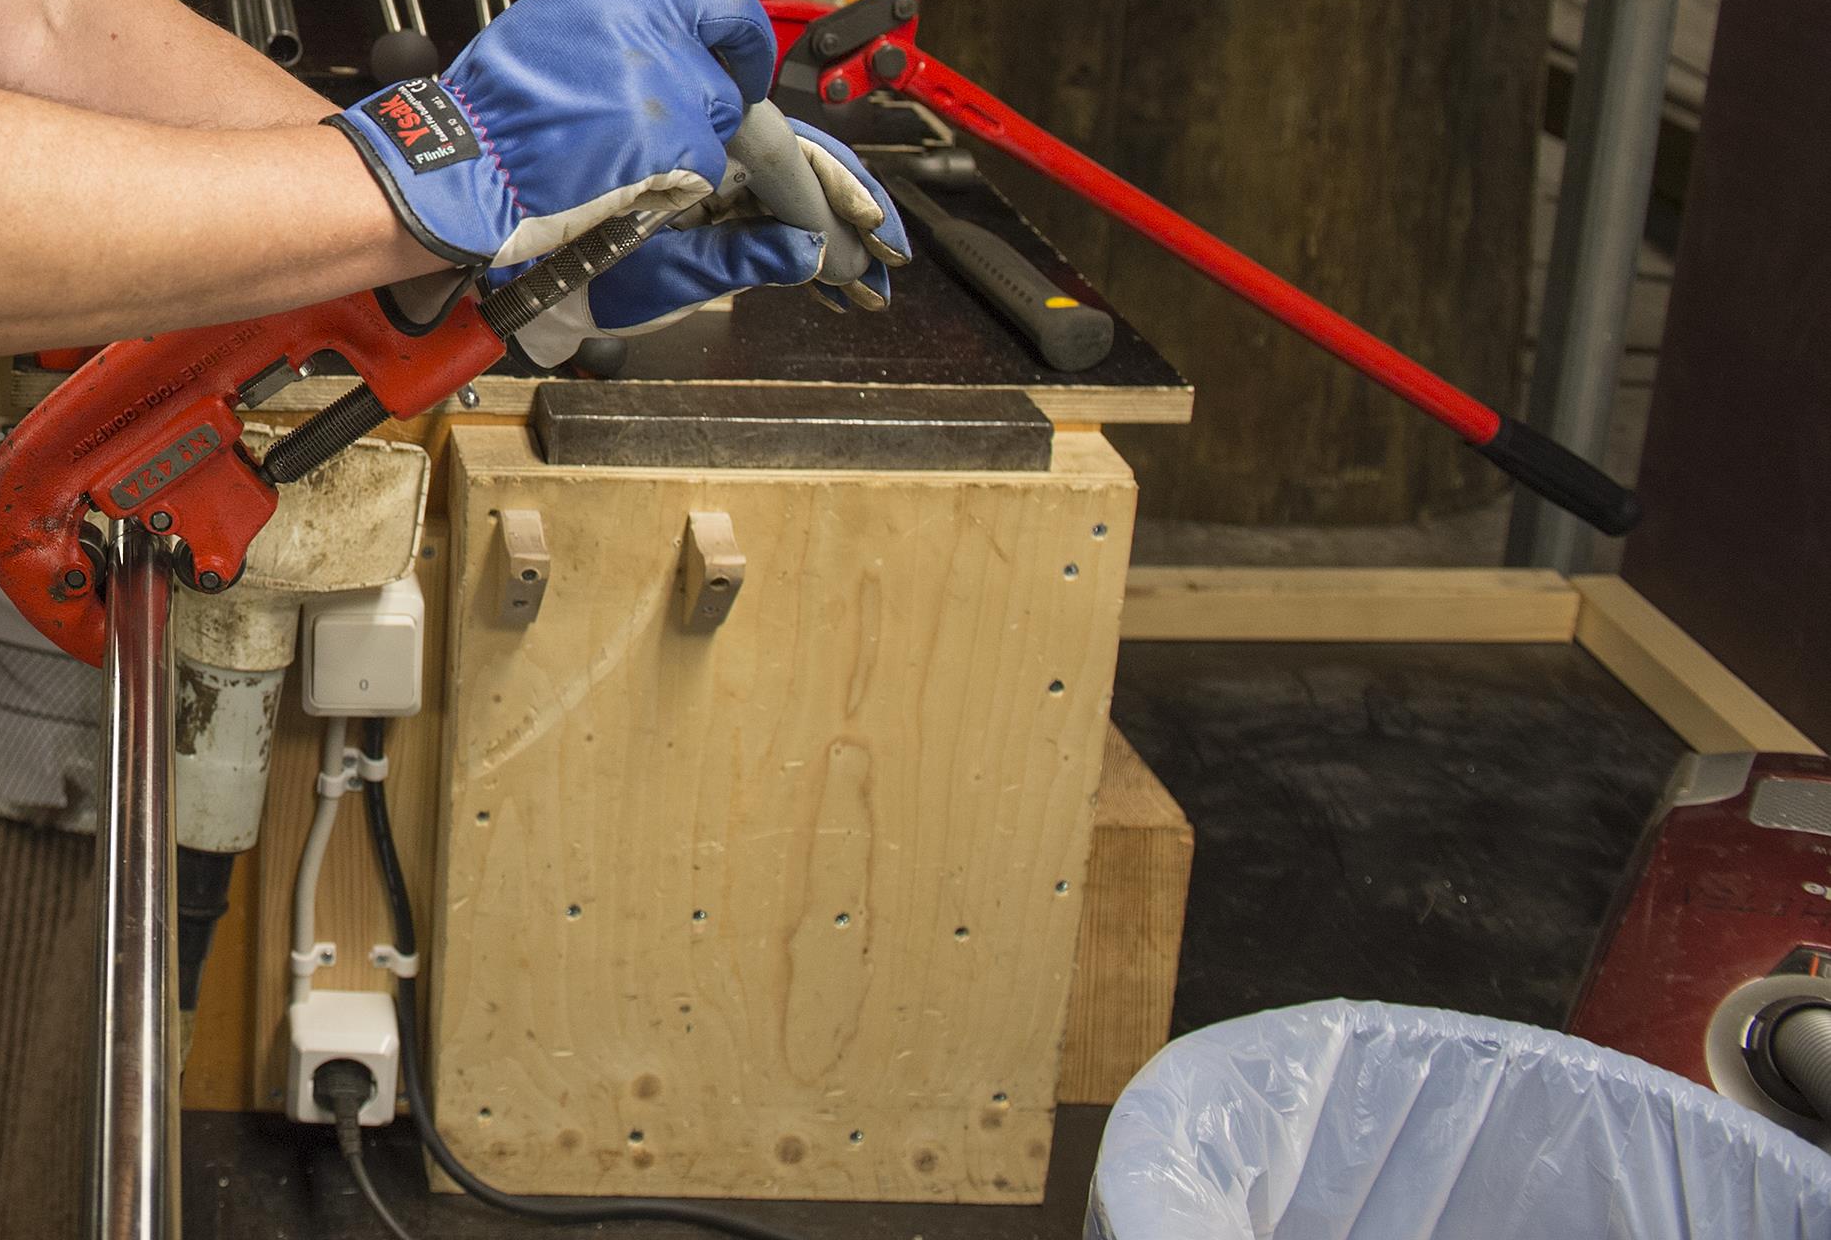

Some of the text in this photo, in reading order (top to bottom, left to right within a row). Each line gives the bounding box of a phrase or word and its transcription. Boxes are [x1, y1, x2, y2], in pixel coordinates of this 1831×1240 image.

[378, 94, 430, 147] Ysak
[414, 145, 456, 164] Flinks
[180, 342, 231, 381] RIDGE
[134, 377, 184, 411] TOOL
[71, 408, 140, 463] COMPANY
[121, 458, 172, 498] 42A
